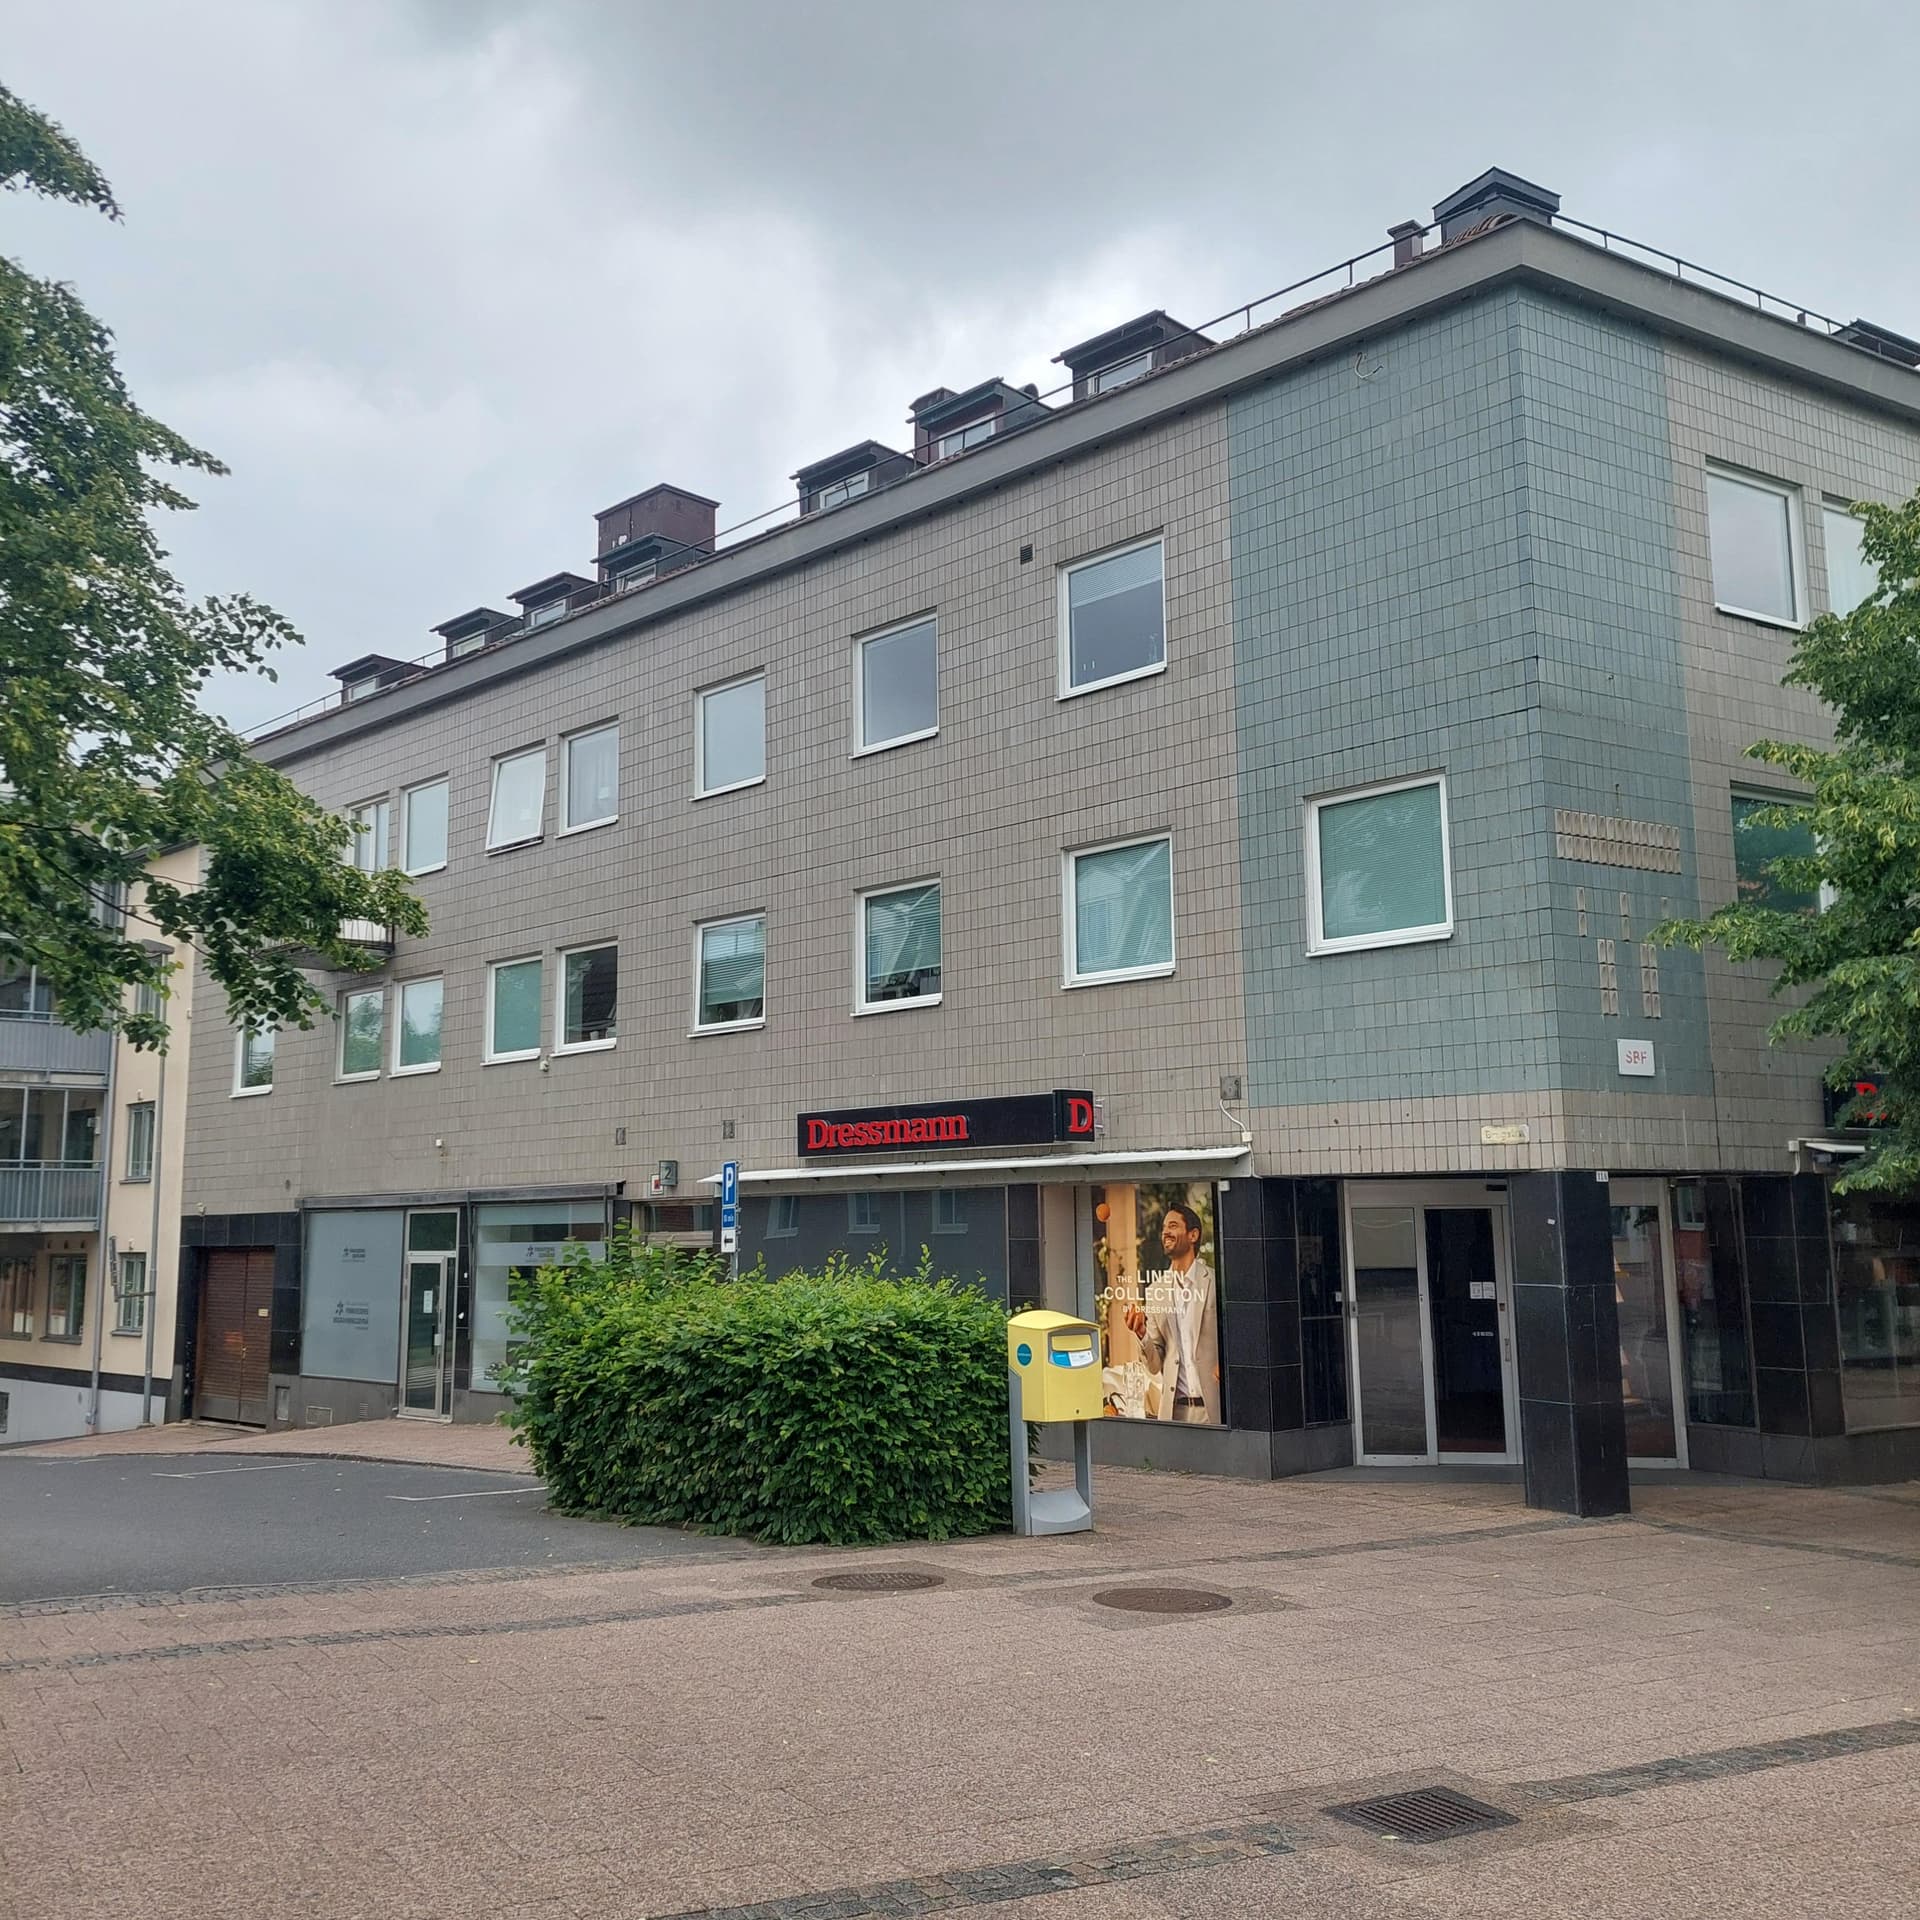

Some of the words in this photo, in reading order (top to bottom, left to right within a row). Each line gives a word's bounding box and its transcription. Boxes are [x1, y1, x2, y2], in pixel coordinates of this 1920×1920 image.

[1625, 1050, 1648, 1065] SBF
[807, 1114, 969, 1149] Dressmann
[663, 1166, 673, 1180] 2
[725, 1166, 735, 1202] P
[1117, 1275, 1132, 1283] THE
[1137, 1270, 1184, 1283] LINEN
[1104, 1286, 1205, 1302] COLLECTION
[1135, 1305, 1185, 1314] DRESSMANN
